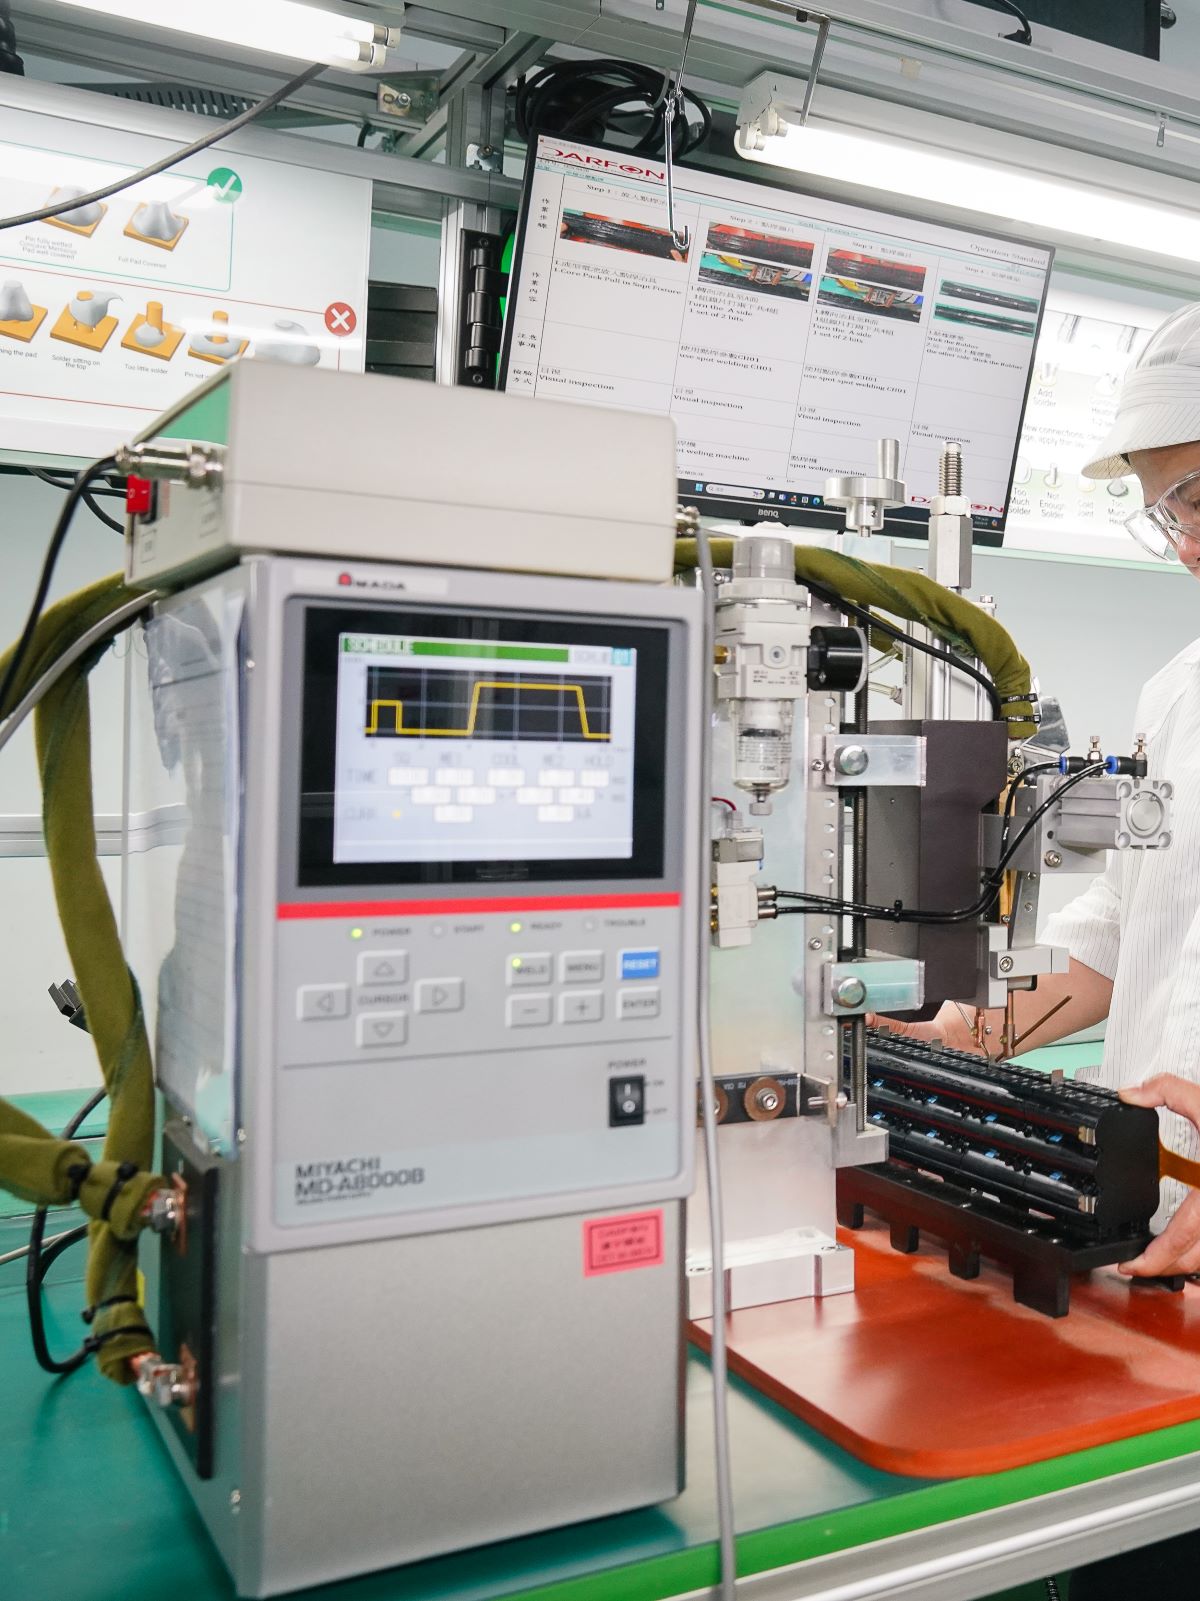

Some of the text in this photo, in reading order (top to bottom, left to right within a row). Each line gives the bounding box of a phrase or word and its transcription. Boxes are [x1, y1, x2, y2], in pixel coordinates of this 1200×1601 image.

[542, 147, 665, 181] DARFON
[970, 243, 1047, 266] Operation Standard
[129, 257, 142, 265] Pad
[142, 260, 168, 269] Covered
[582, 272, 603, 281] Pack
[688, 300, 708, 310] Turn
[710, 303, 724, 311] the
[14, 349, 24, 357] the
[25, 352, 38, 360] pad
[52, 354, 72, 363] Solder
[72, 357, 92, 367] sitting
[717, 358, 748, 369] welding
[137, 365, 149, 373] little
[150, 367, 168, 375] solder
[539, 374, 615, 391] Visual inspection
[855, 382, 885, 391] welding
[1038, 388, 1053, 397] Add
[674, 395, 743, 410] Visual inspection
[1034, 398, 1057, 408] Solder
[797, 413, 861, 427] Visual inspection
[911, 430, 971, 443] Visual inspection
[715, 453, 750, 462] machine
[835, 468, 867, 477] machine
[1014, 487, 1027, 497] Too
[1010, 496, 1030, 506] Much
[1039, 500, 1065, 511] Enough
[758, 508, 779, 519] BenQ
[1008, 505, 1031, 515] Solder
[1041, 508, 1064, 520] Solder
[604, 917, 646, 927] TROUBLE
[373, 927, 411, 936] POWER
[567, 963, 599, 973] MENU
[623, 958, 657, 970] RESET
[358, 993, 409, 1006] CURSOR
[623, 999, 657, 1009] ENTER
[608, 1058, 646, 1069] POWER
[295, 1157, 381, 1178] MIYACHI
